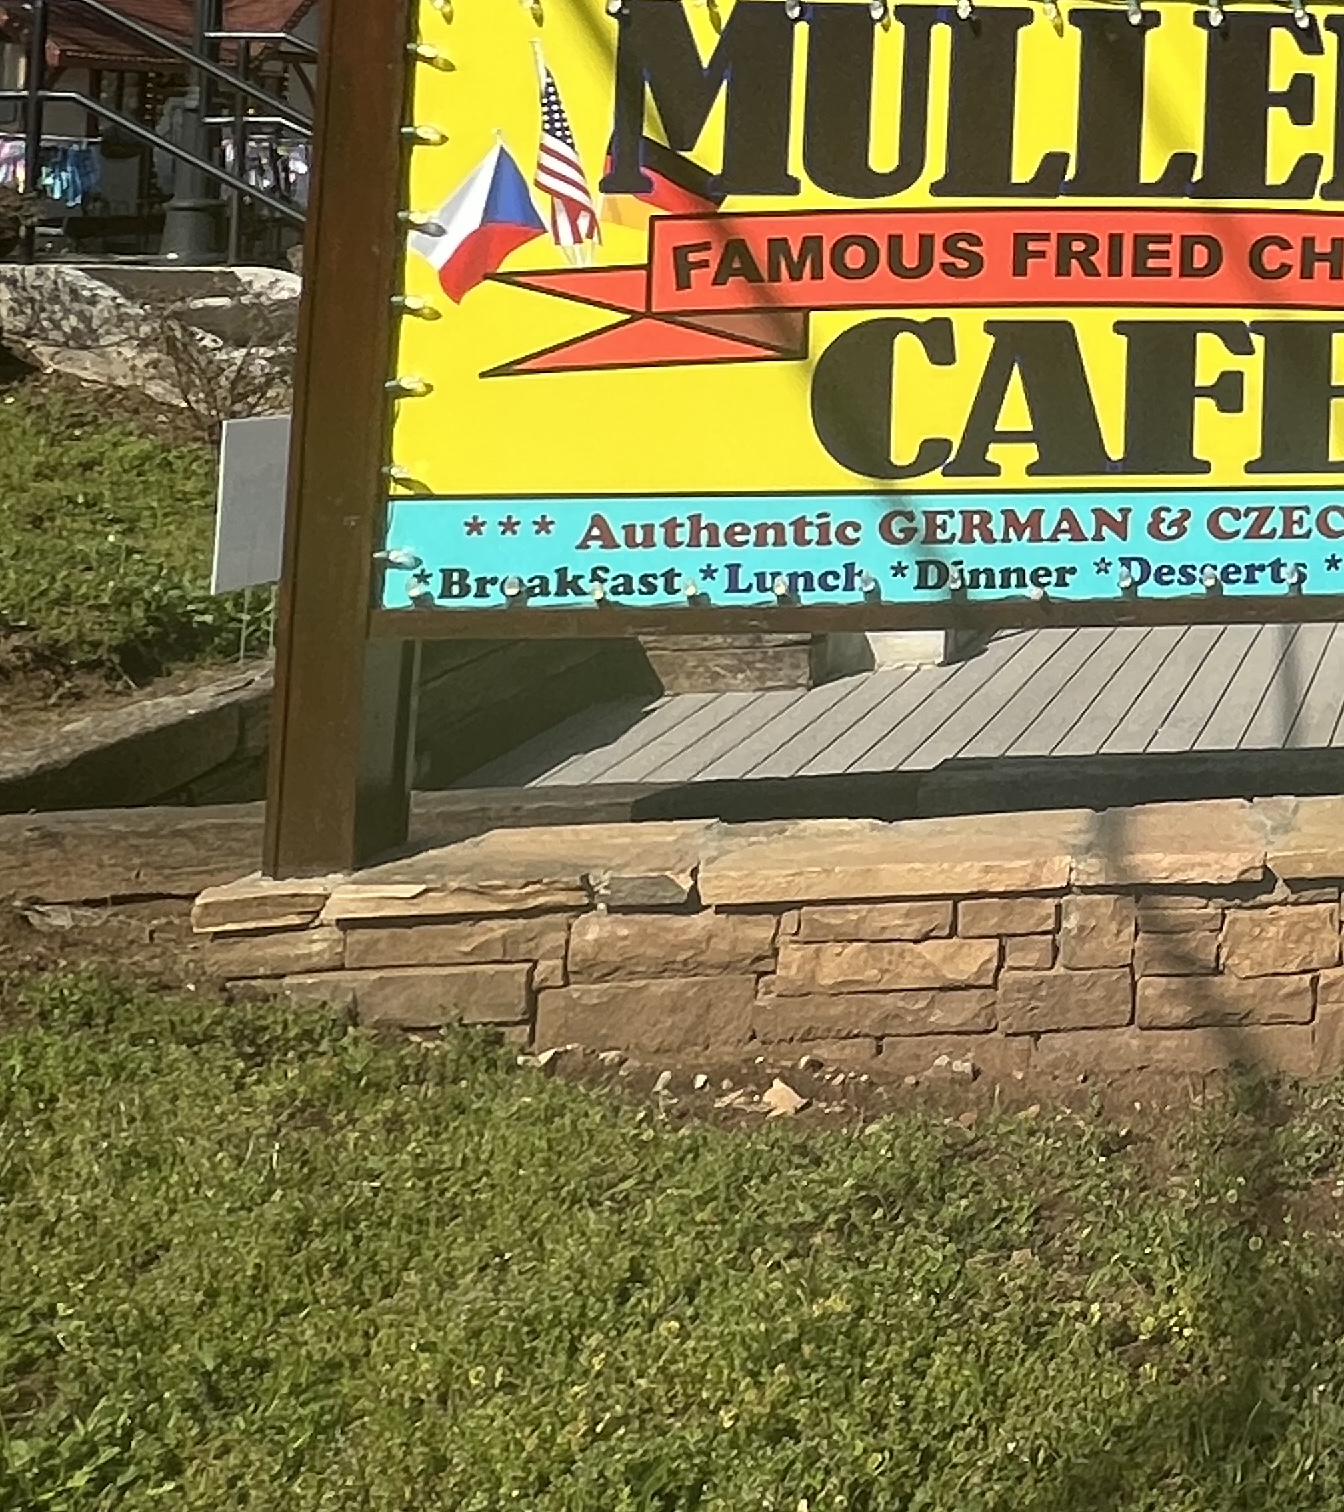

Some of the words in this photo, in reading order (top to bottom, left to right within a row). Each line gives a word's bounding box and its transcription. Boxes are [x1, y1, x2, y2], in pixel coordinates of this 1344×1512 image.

[672, 230, 985, 292] FAMOUS
[1012, 231, 1223, 280] FRIED
[575, 511, 862, 551] Authentic
[878, 507, 1132, 546] GERMAN
[1146, 505, 1192, 541] &
